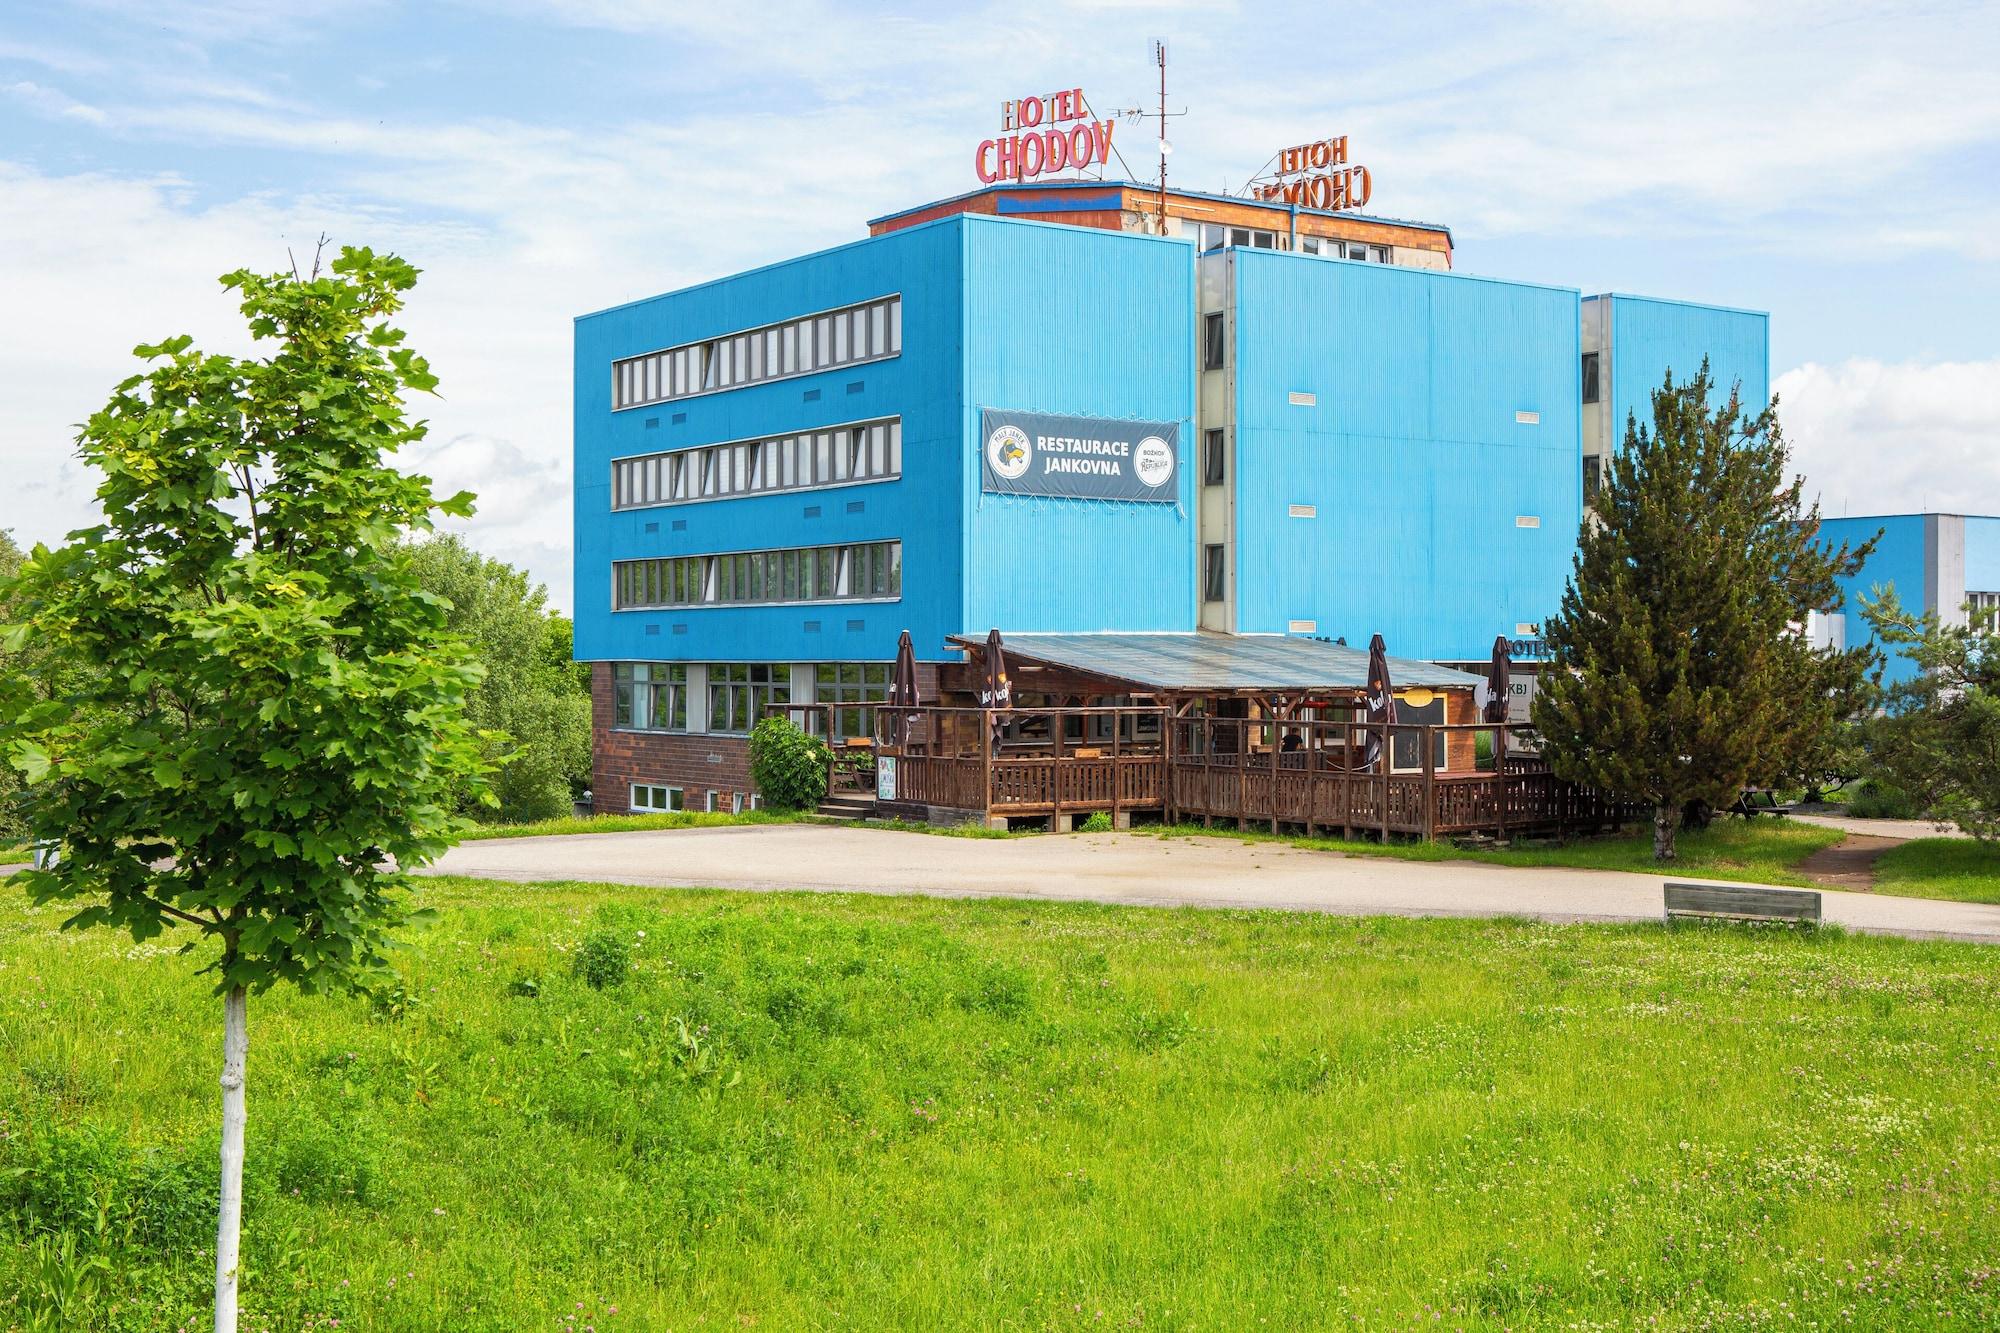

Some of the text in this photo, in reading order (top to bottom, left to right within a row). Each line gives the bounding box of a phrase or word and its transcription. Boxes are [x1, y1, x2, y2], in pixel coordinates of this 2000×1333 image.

[1001, 88, 1088, 132] HOTEL
[975, 119, 1114, 184] CHODOV
[1037, 436, 1129, 457] RESTAURACE
[1044, 457, 1121, 476] JANKOVNA
